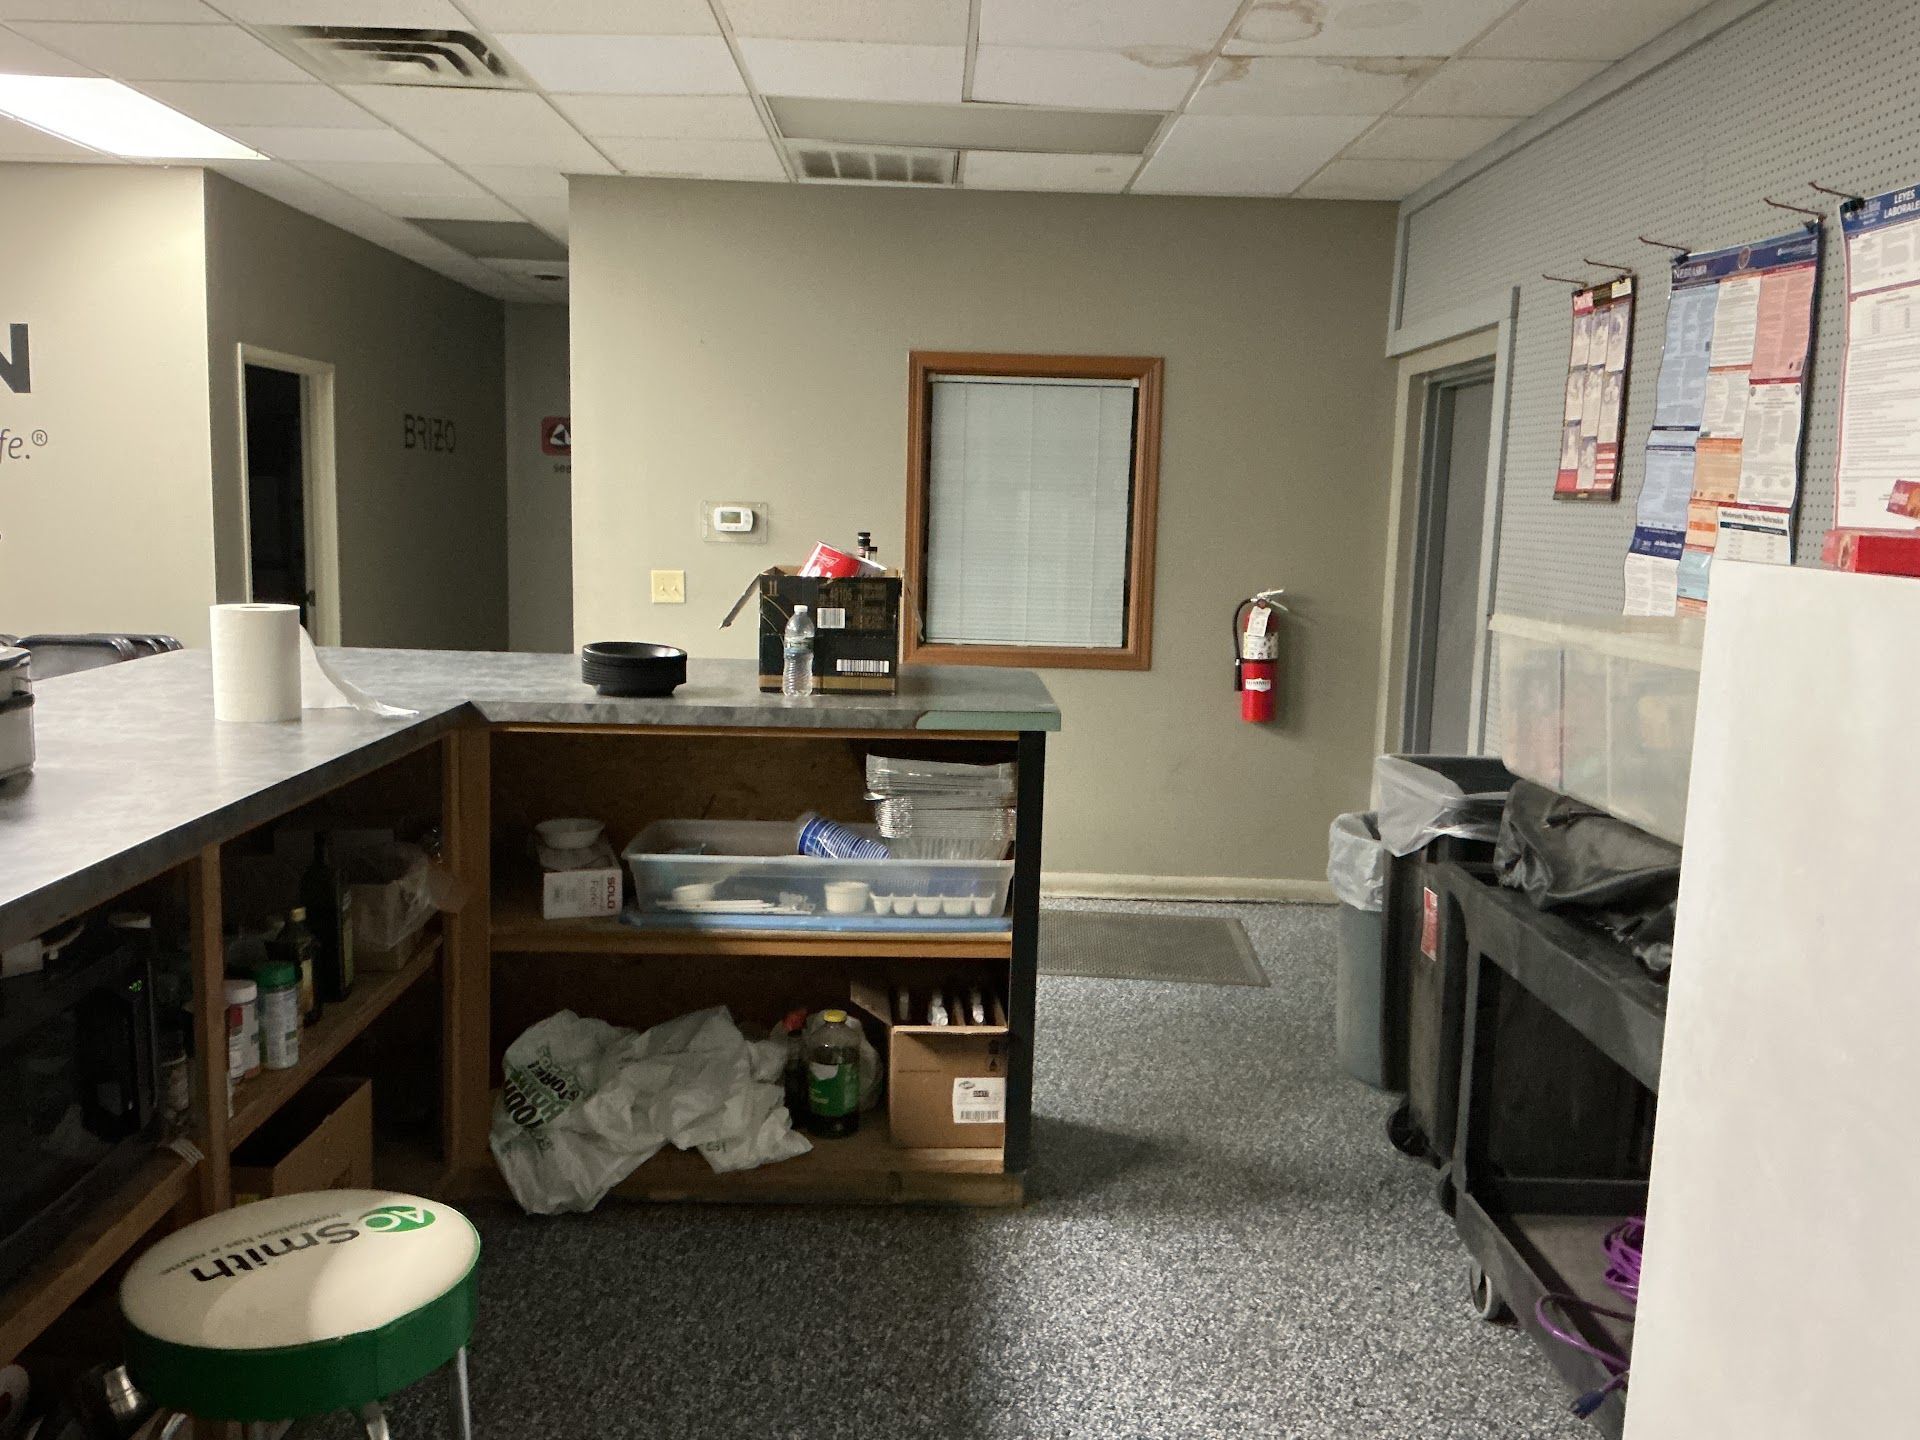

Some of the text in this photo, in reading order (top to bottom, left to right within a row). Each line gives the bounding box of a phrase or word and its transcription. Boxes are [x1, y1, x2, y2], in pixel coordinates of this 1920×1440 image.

[1894, 189, 1916, 204] LEYES
[607, 876, 616, 909] SOLO
[190, 1221, 360, 1282] Smith
